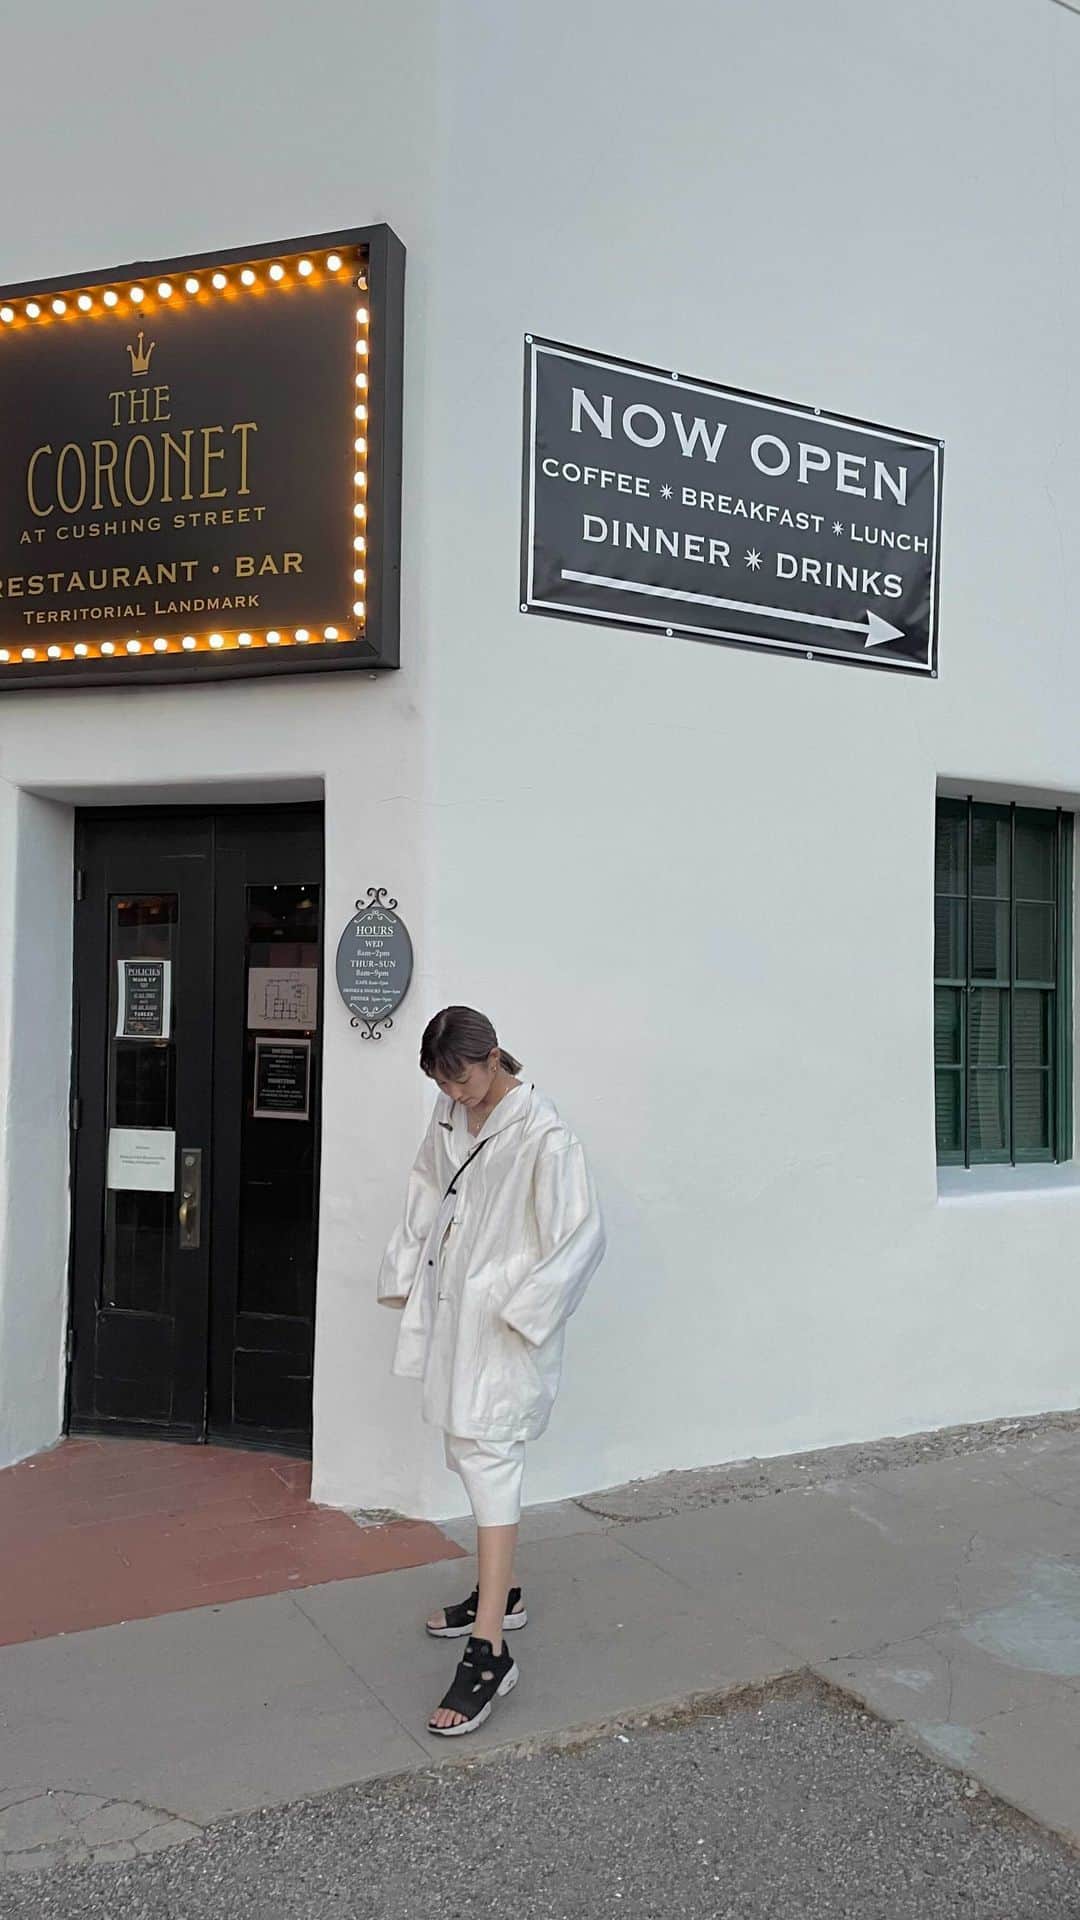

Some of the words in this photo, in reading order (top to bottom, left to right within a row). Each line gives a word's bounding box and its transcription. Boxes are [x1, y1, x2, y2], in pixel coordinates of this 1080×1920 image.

[108, 385, 172, 427] THE
[570, 387, 728, 463] NOW
[750, 434, 908, 506] OPEN
[26, 422, 259, 517] CORONET
[19, 528, 47, 545] AT
[56, 515, 162, 541] CUSHING
[173, 506, 267, 529] STREET
[541, 458, 651, 498] COFFEE
[681, 487, 825, 534] BREAKFAST
[850, 523, 929, 554] LUNCH
[0, 560, 199, 598] ESTAURANT
[235, 552, 304, 578] BAR
[582, 514, 731, 567] DINNER
[776, 552, 903, 599] DRINKS
[23, 602, 146, 625] TERRITORIAL
[154, 595, 260, 615] LANDMARK
[356, 925, 394, 936] HOURS
[365, 940, 383, 948] WED
